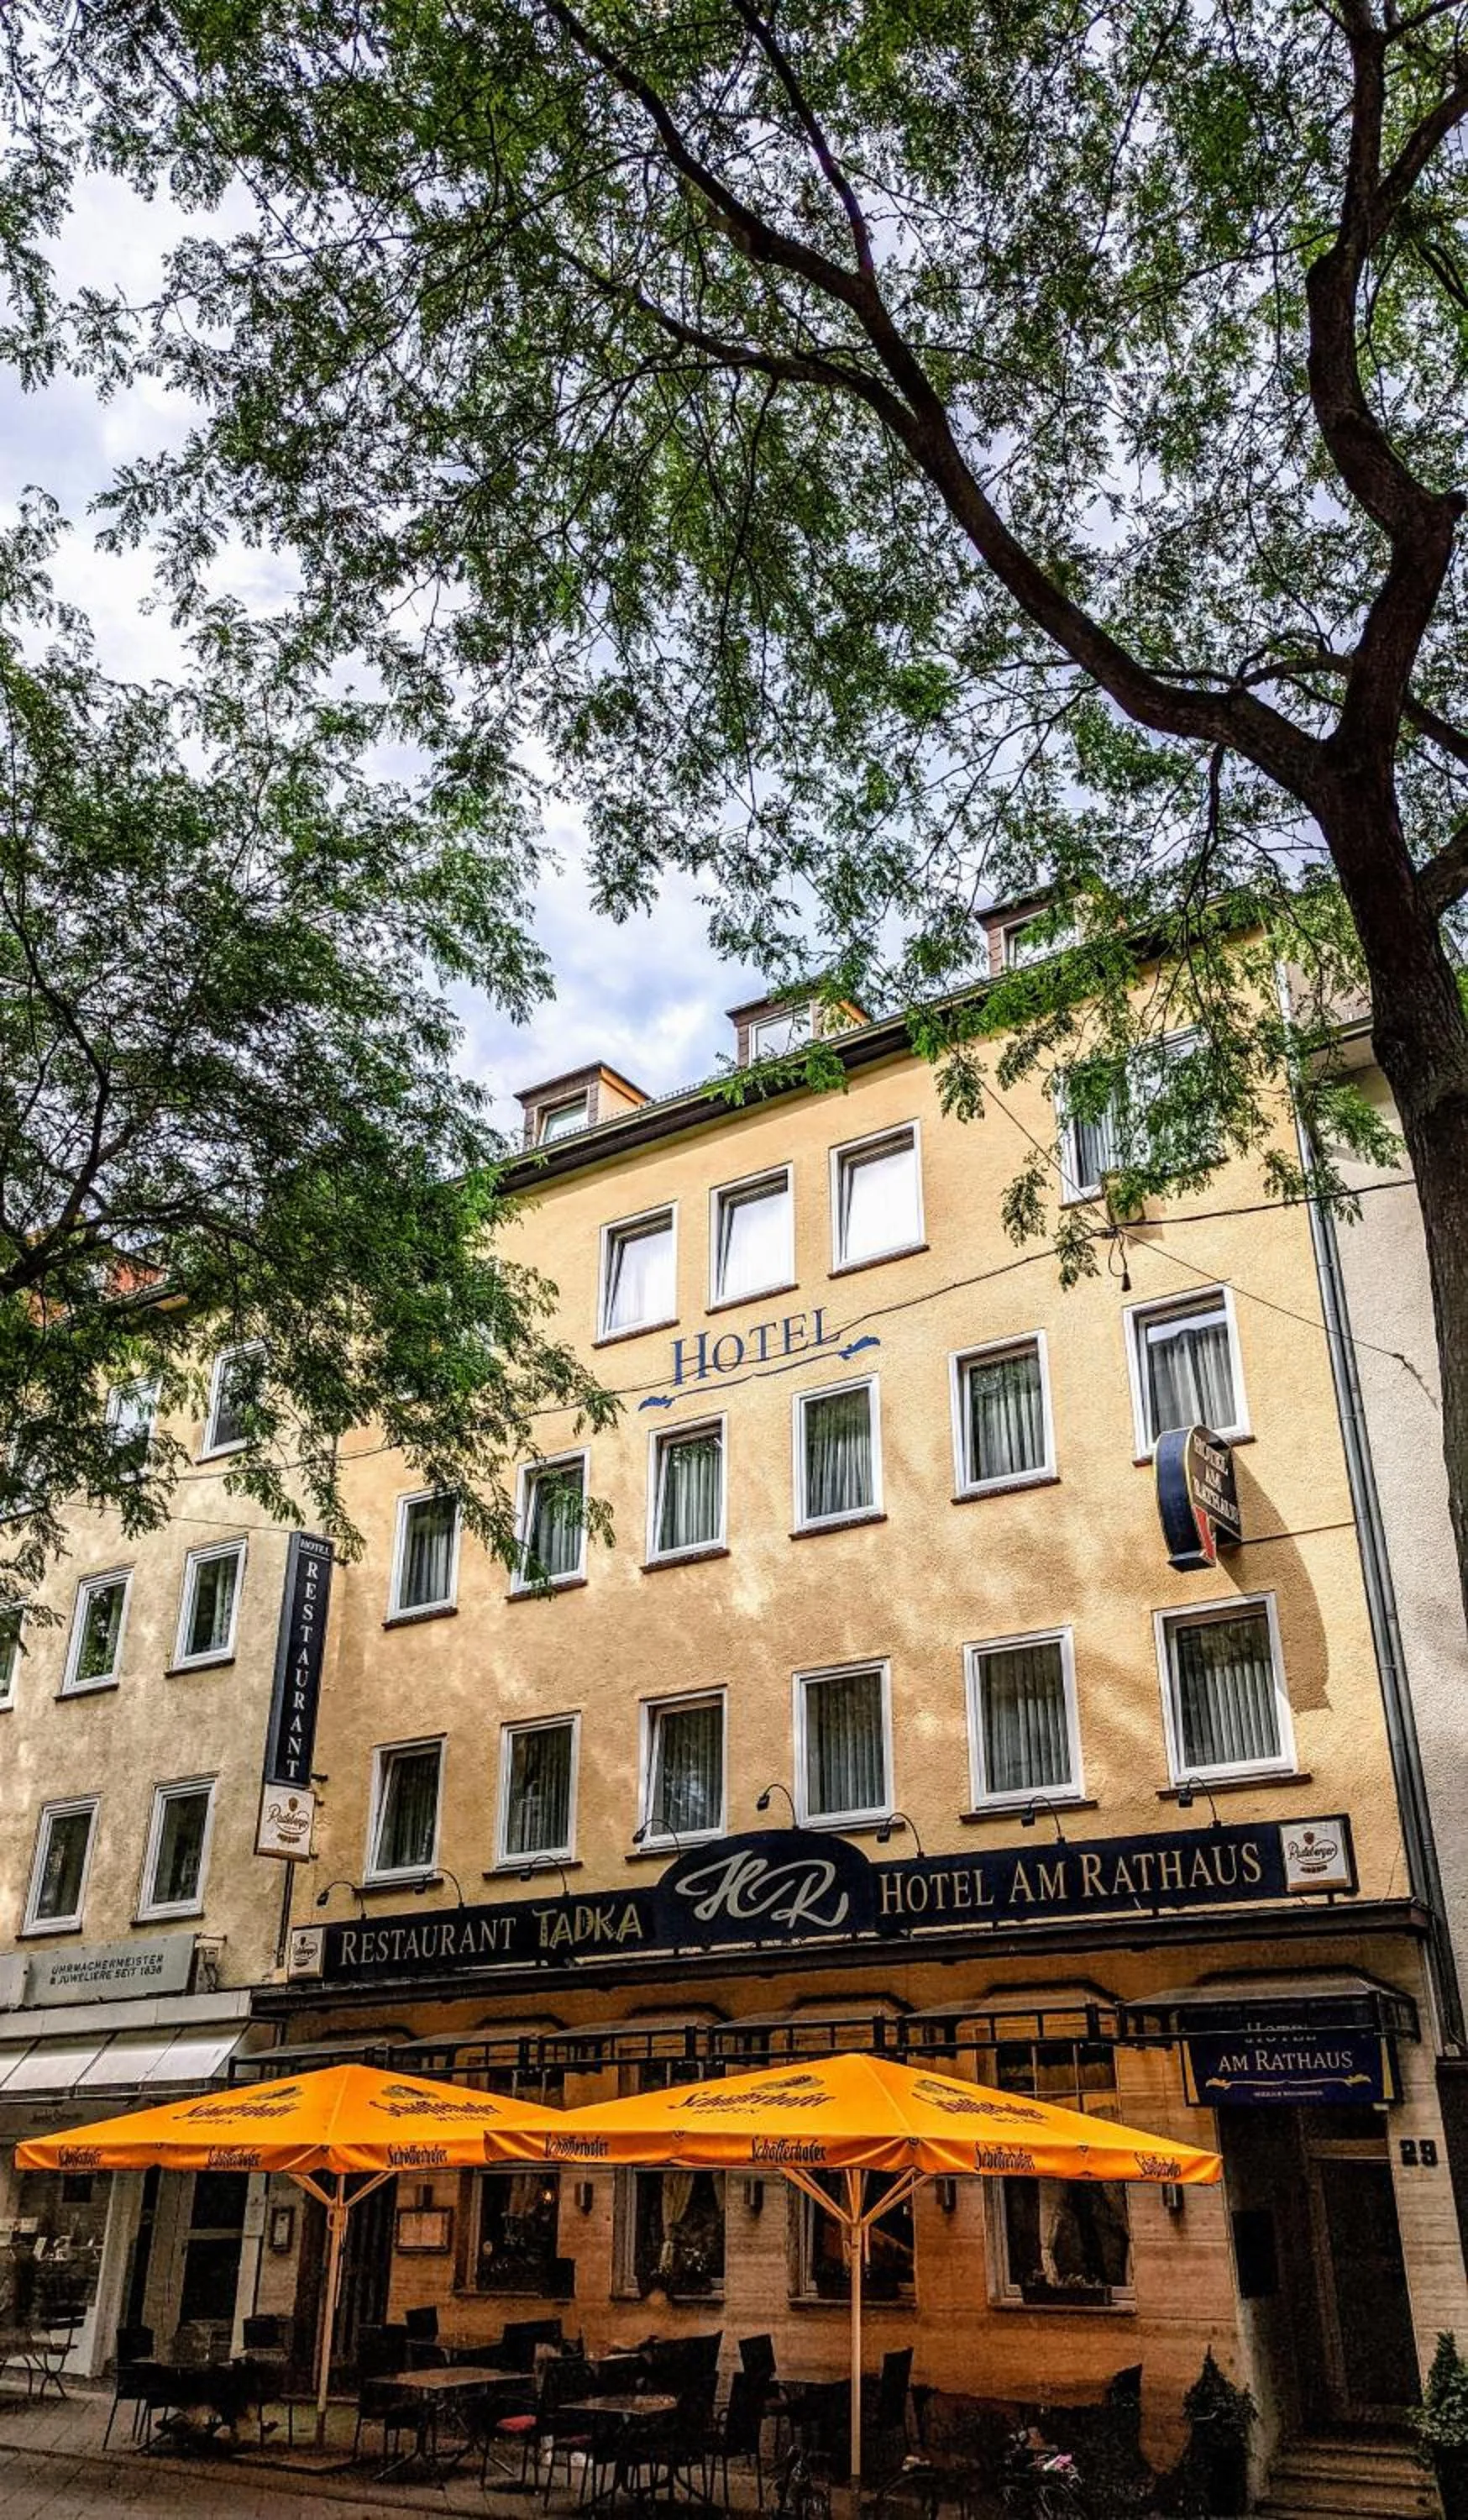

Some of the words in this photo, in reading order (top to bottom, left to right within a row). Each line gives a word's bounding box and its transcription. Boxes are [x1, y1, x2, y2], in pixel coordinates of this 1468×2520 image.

[671, 1307, 841, 1386] HOTEL
[1205, 1464, 1223, 1493] AM
[300, 1538, 330, 1556] HOTEL
[287, 1560, 320, 1779] RESTAURANT
[878, 1869, 995, 1915] HOTEL
[1009, 1859, 1069, 1904] AM
[1079, 1842, 1261, 1898] RATHAUS
[339, 1917, 516, 1966] RESTAURANT
[532, 1903, 644, 1950] TADKA
[51, 1954, 165, 1975] UHRMACHERMEISTER
[58, 1970, 112, 1984] JUWELIERE
[114, 1967, 137, 1978] SEIT
[1218, 2055, 1249, 2072] AM
[1255, 2050, 1354, 2071] RATHAUS
[748, 2136, 827, 2164] Schöfferhofer
